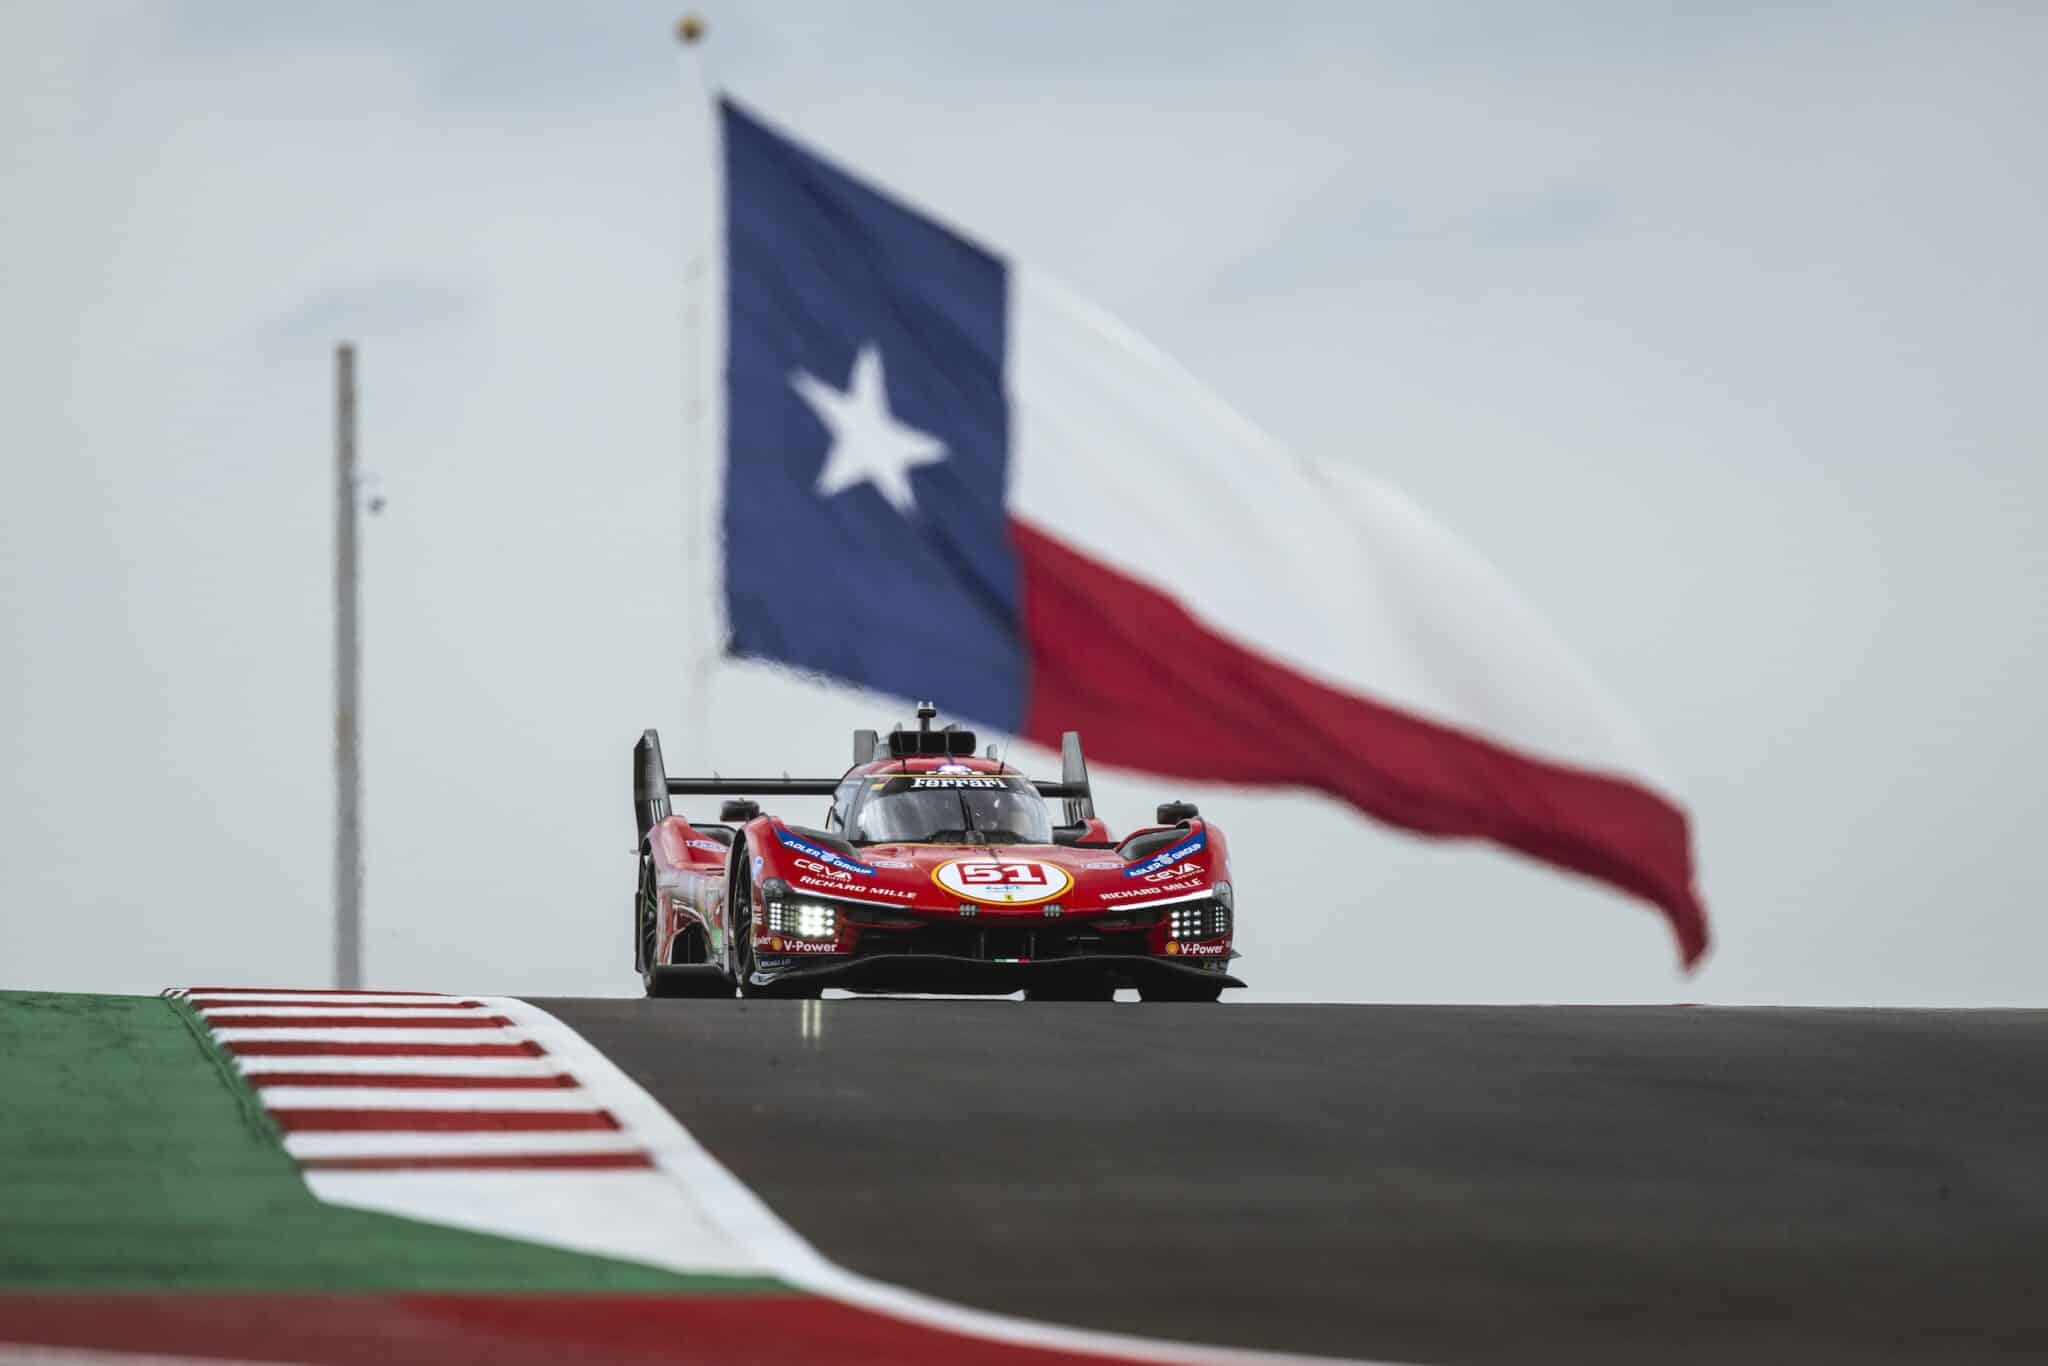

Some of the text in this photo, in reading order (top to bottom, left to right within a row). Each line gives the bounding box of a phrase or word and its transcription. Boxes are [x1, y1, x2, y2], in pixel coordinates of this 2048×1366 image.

[910, 777, 1008, 788] Ferrari
[784, 841, 821, 857] ADLER
[833, 860, 873, 874] GROUP
[963, 864, 1041, 882] 51
[1129, 862, 1163, 876] ADLER
[800, 876, 867, 892] RICHARD
[870, 887, 917, 899] MILLE
[1099, 878, 1203, 900] RICHARD MILLE
[784, 940, 838, 952] V-Power
[1181, 943, 1224, 954] V-Power
